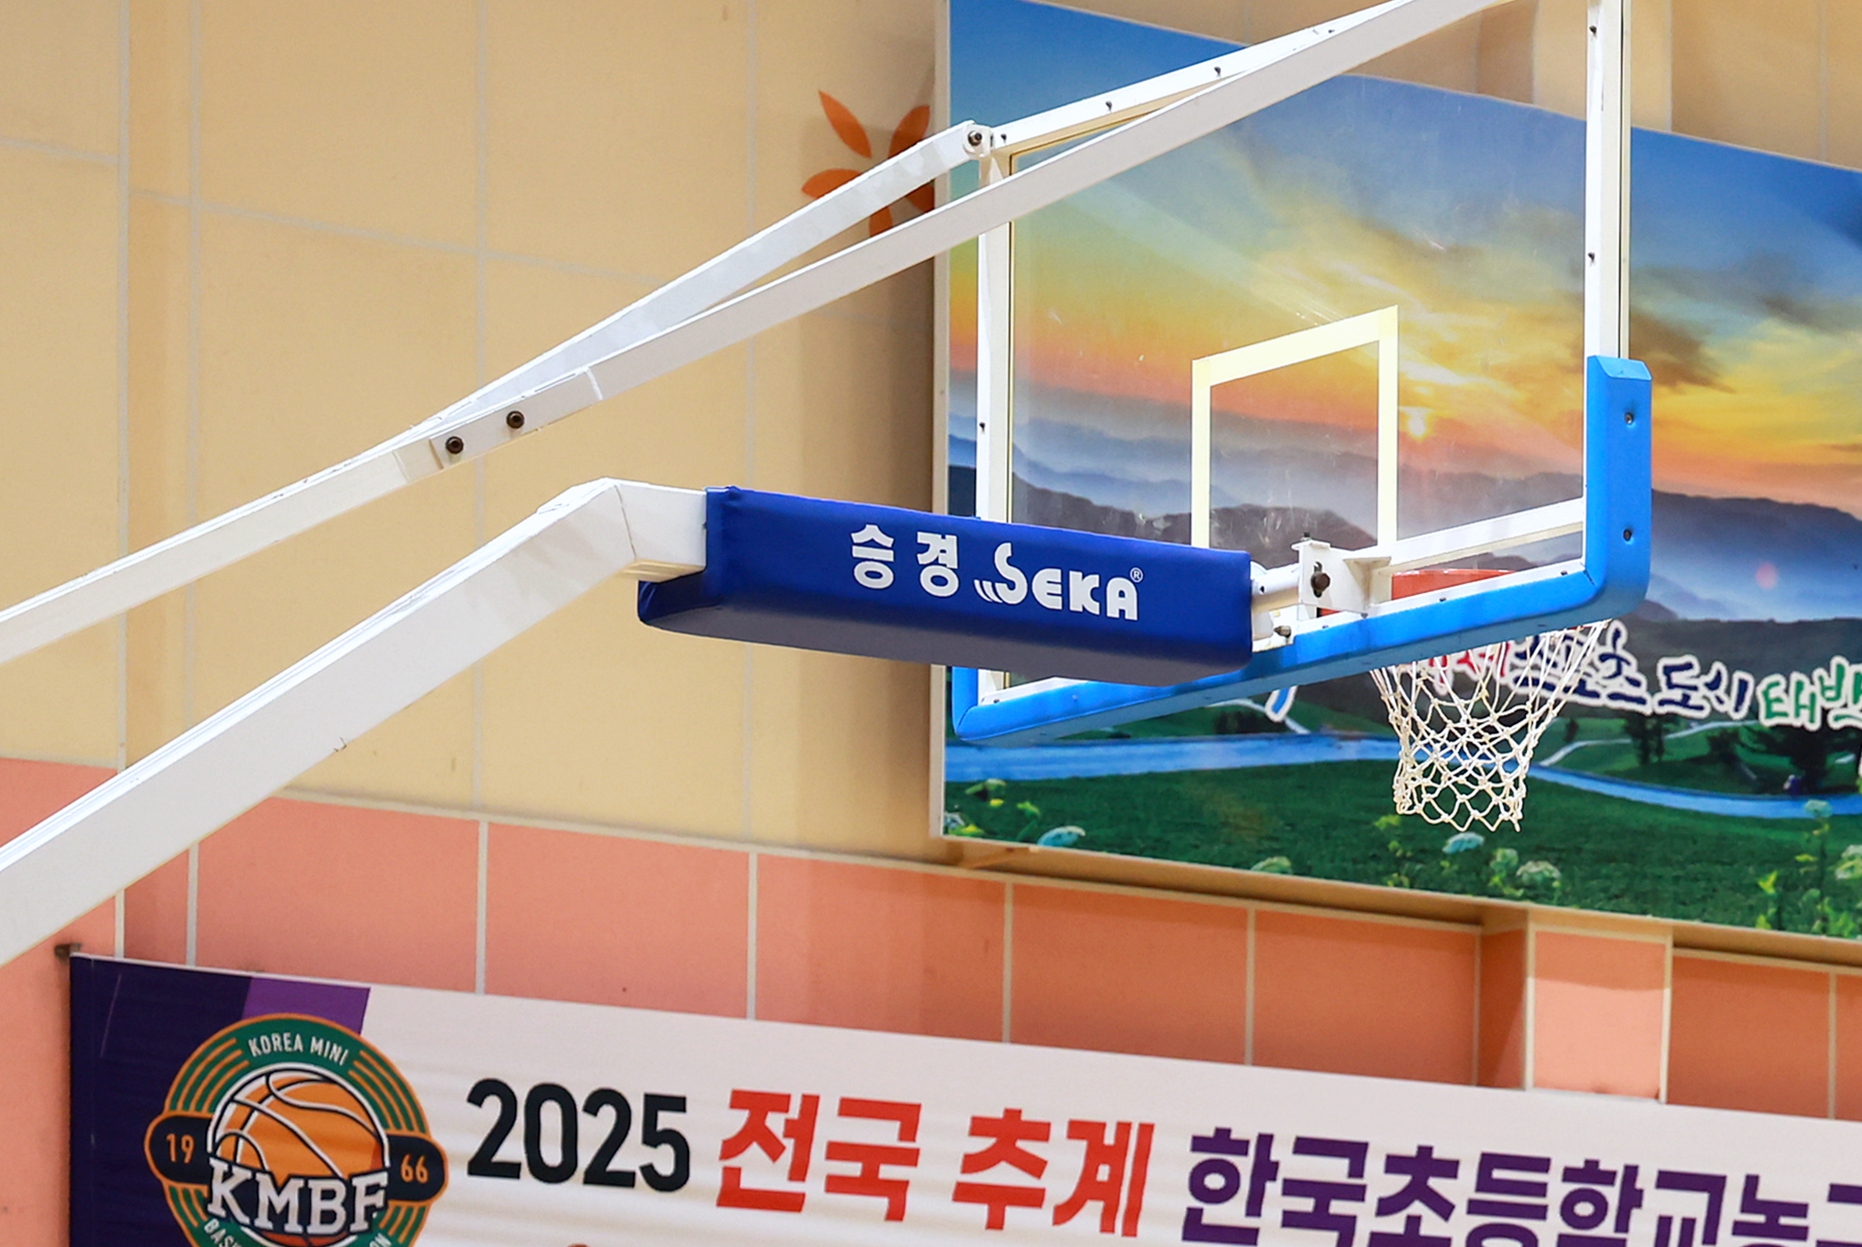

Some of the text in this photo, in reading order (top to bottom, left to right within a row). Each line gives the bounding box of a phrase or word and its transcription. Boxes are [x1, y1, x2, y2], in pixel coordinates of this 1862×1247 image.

[1656, 657, 1752, 716] 도시
[248, 1032, 348, 1066] KOREA MINI
[166, 1133, 194, 1164] 19
[401, 1154, 429, 1183] 66
[467, 1077, 690, 1192] 2025
[716, 1088, 921, 1222] 전국
[952, 1107, 1155, 1238] 추계
[207, 1157, 389, 1235] KMBF
